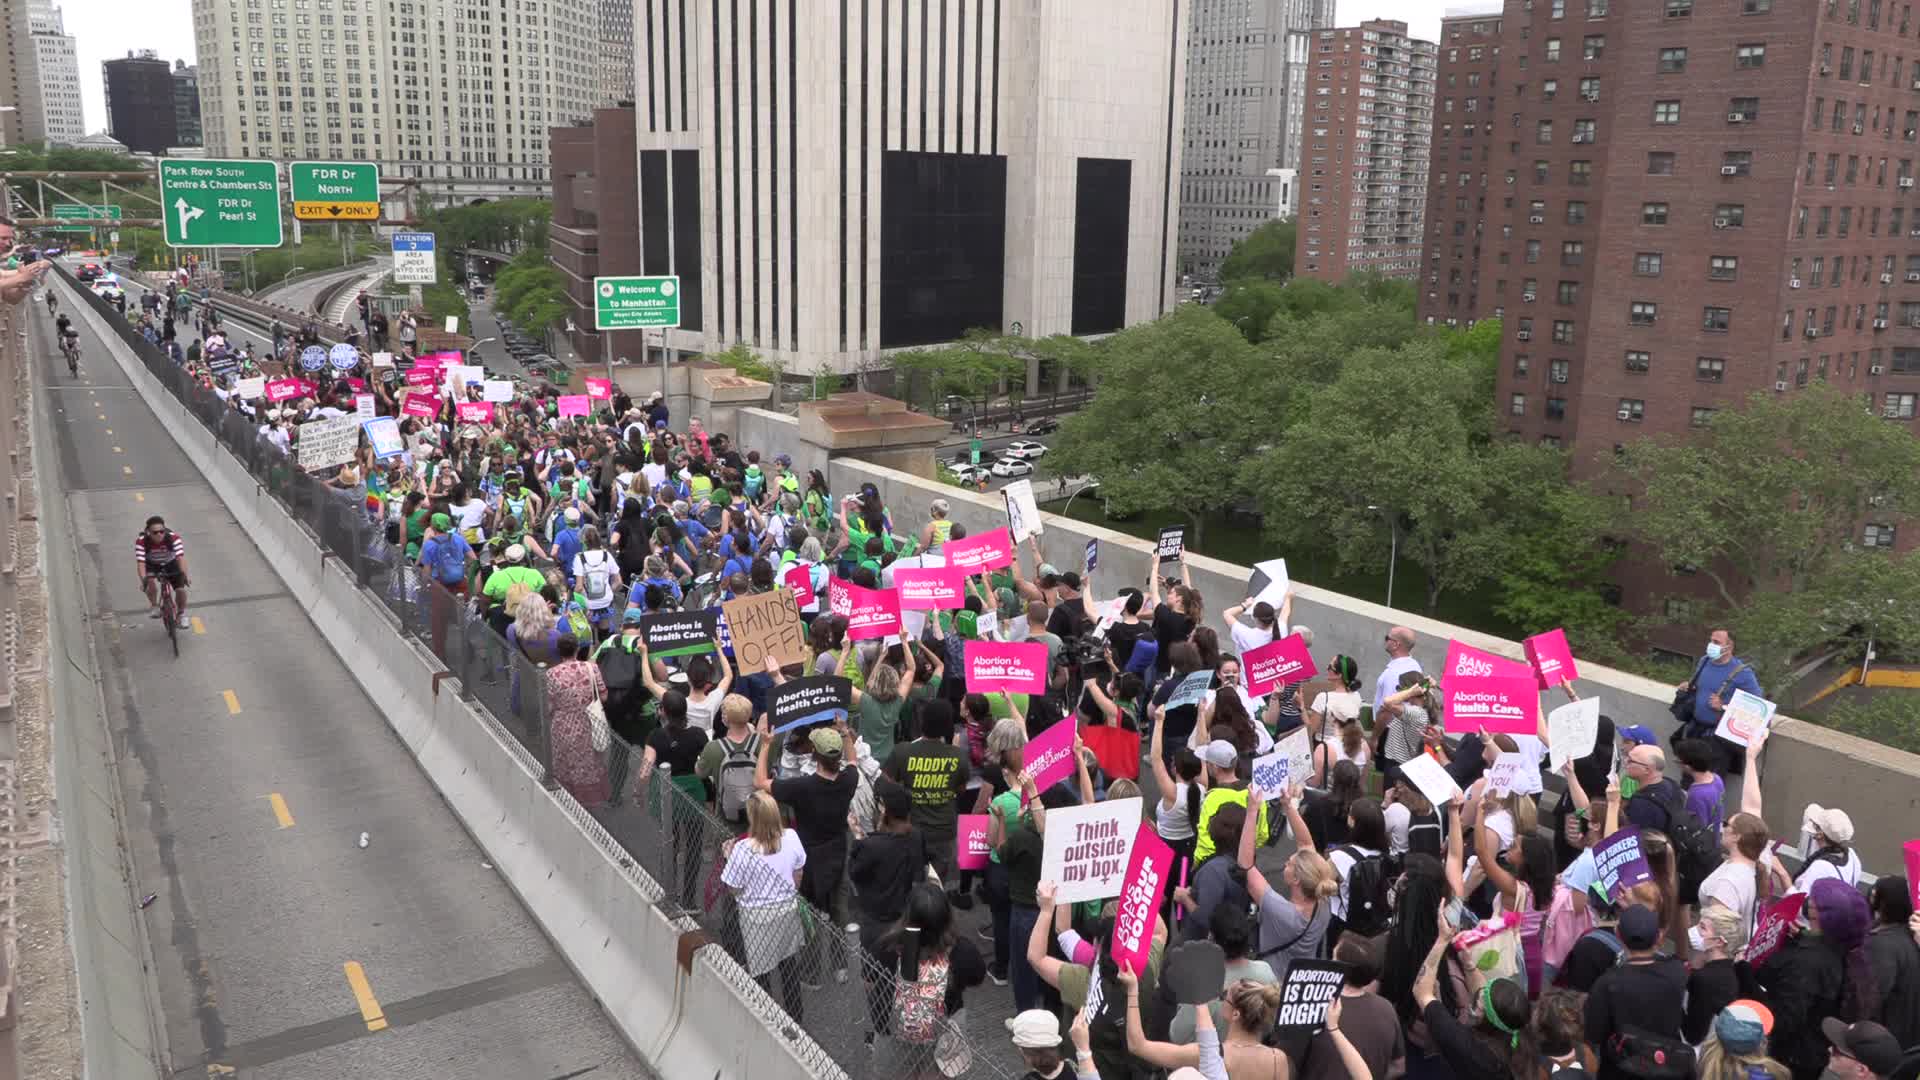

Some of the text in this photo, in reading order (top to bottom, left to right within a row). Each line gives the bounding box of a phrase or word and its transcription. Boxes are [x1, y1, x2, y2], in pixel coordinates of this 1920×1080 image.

[165, 166, 188, 176] Park
[191, 167, 213, 176] Row
[312, 169, 356, 179] FDR Dr
[166, 180, 273, 190] Centre & Chambers Sts
[318, 184, 353, 194] NORTH
[218, 199, 252, 208] FDR Dr
[219, 212, 257, 221] Pearl St
[300, 206, 373, 215] EXIT ONLY
[618, 286, 656, 294] Welcome
[609, 299, 667, 308] to Manhattan
[1160, 537, 1181, 546] IS OUR
[952, 547, 984, 558] Abortion
[1159, 545, 1180, 556] RIGHT
[953, 550, 1003, 565] Health Care.
[903, 587, 955, 596] Health Care.
[727, 591, 799, 639] HANDS
[872, 612, 896, 620] Care.
[650, 621, 702, 633] Abortion is
[650, 631, 707, 643] Health Care.
[742, 625, 803, 666] OFF!
[974, 656, 1021, 665] Abortion is
[1252, 655, 1285, 672] Abortion is
[1459, 653, 1493, 675] BANS
[974, 666, 1034, 677] Health Care.
[1253, 660, 1301, 681] Health Care.
[776, 685, 835, 706] Abortion is
[1453, 691, 1508, 703] Abortion is
[776, 695, 841, 716] Health Care.
[1453, 703, 1524, 715] Health Care.
[907, 757, 959, 772] DADDY'S
[1276, 758, 1289, 770] MY
[912, 773, 950, 788] HOME
[1491, 777, 1511, 786] YOU
[1076, 818, 1120, 842] Think
[1064, 838, 1126, 863] outside
[1607, 847, 1641, 870] ABORTION
[1063, 858, 1124, 883] my box.
[1120, 855, 1154, 946] OFF OUR
[1117, 883, 1136, 941] BANS
[1126, 872, 1159, 953] BODIES
[1288, 968, 1344, 985] ABORTION
[1283, 984, 1337, 1003] IS OUR
[1279, 1002, 1329, 1025] RIGHT
